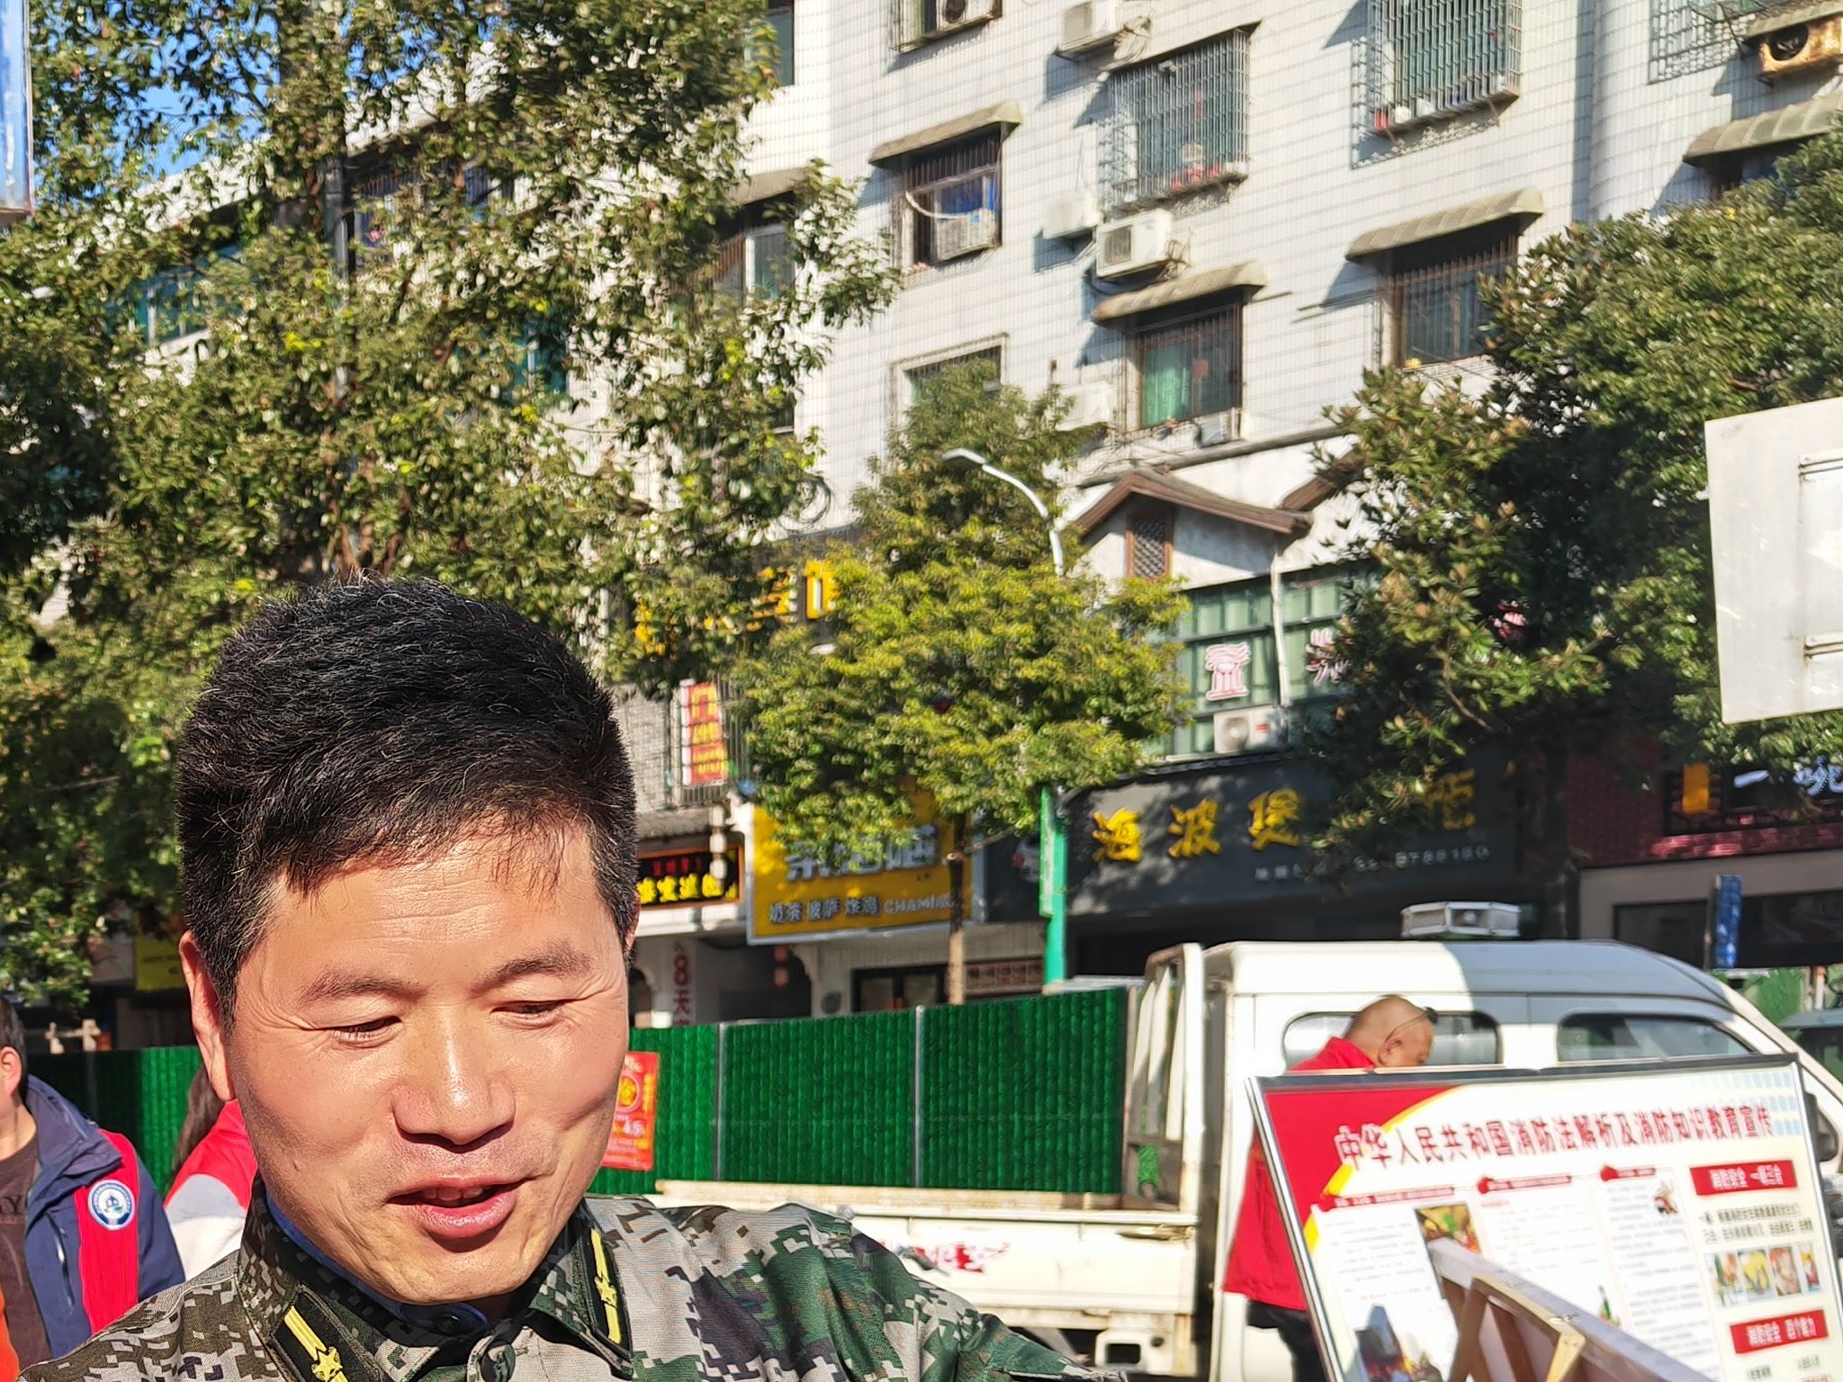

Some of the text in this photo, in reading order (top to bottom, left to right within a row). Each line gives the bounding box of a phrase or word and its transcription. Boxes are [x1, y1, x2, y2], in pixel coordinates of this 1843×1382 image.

[1334, 1103, 1774, 1170] 中华人民共和国消防法解析及消防知识教育宣传
